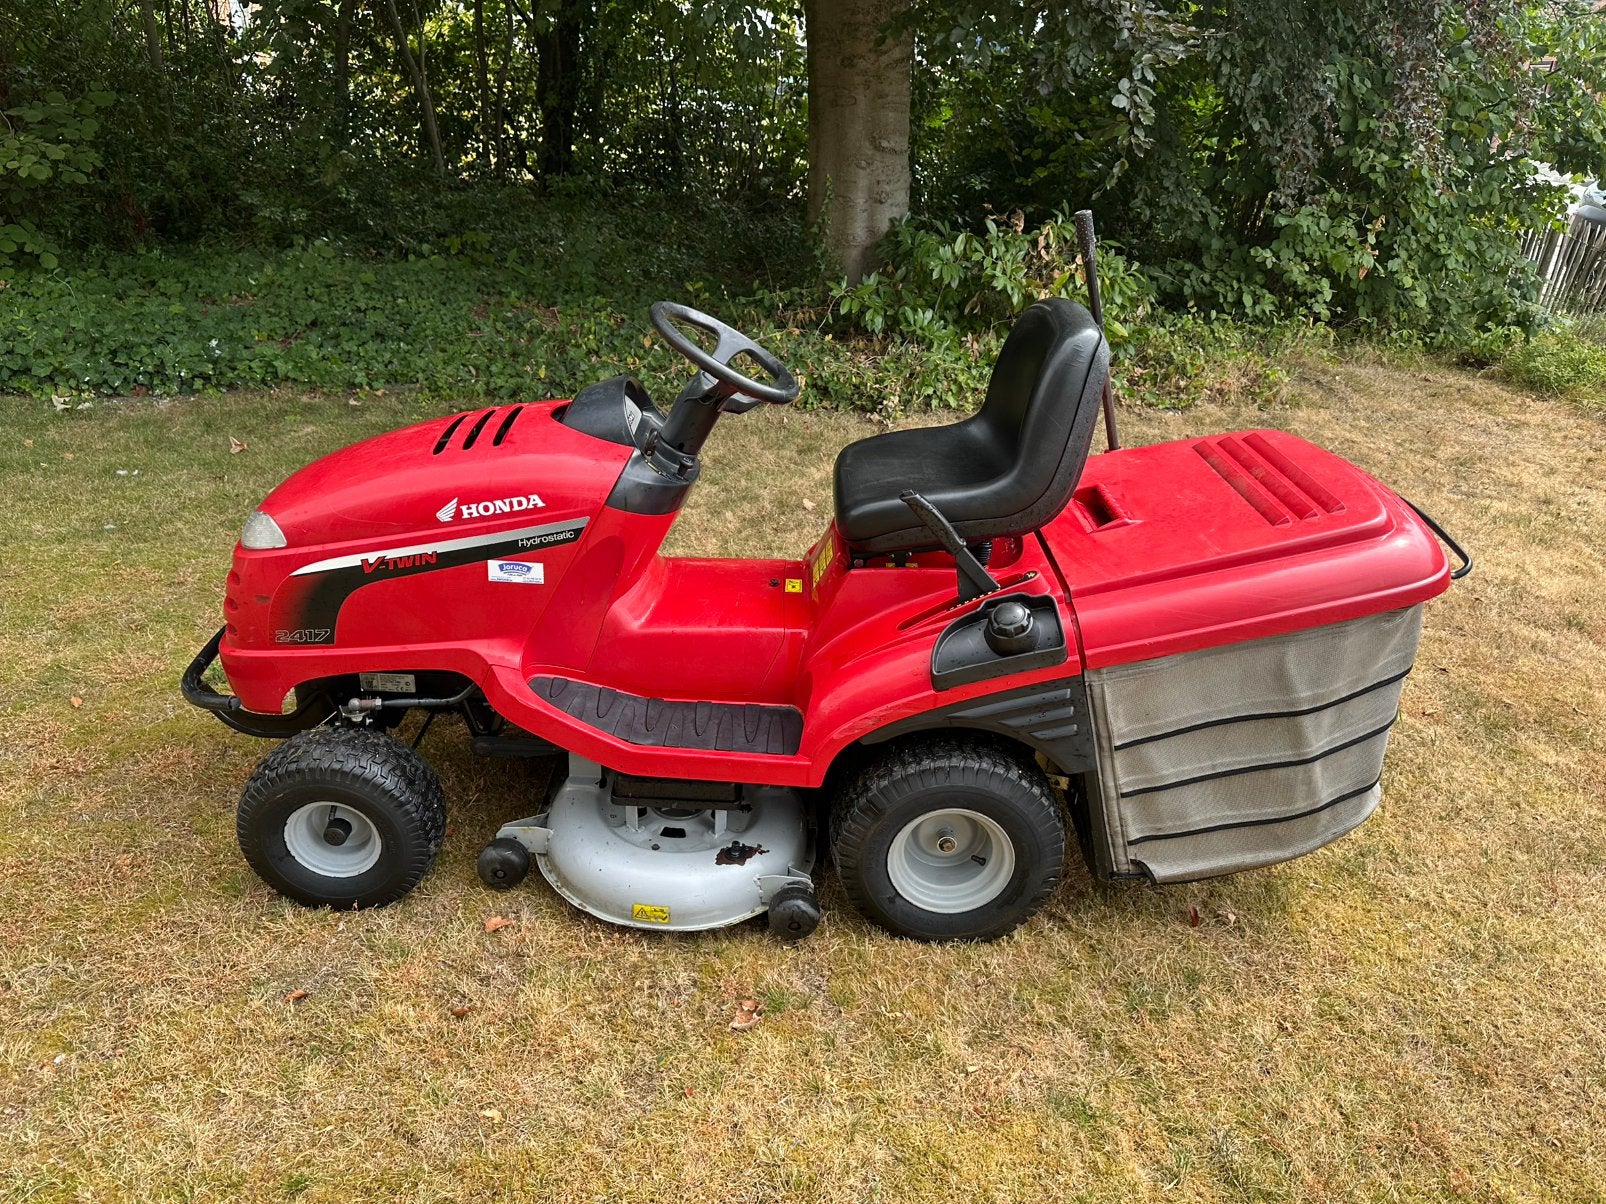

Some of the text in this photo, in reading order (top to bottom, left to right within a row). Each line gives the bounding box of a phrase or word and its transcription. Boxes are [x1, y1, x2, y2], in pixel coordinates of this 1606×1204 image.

[460, 494, 546, 519] HONDA
[518, 530, 575, 548] Hydrostatic
[361, 551, 437, 574] V-TWIN
[275, 628, 331, 643] 2417
